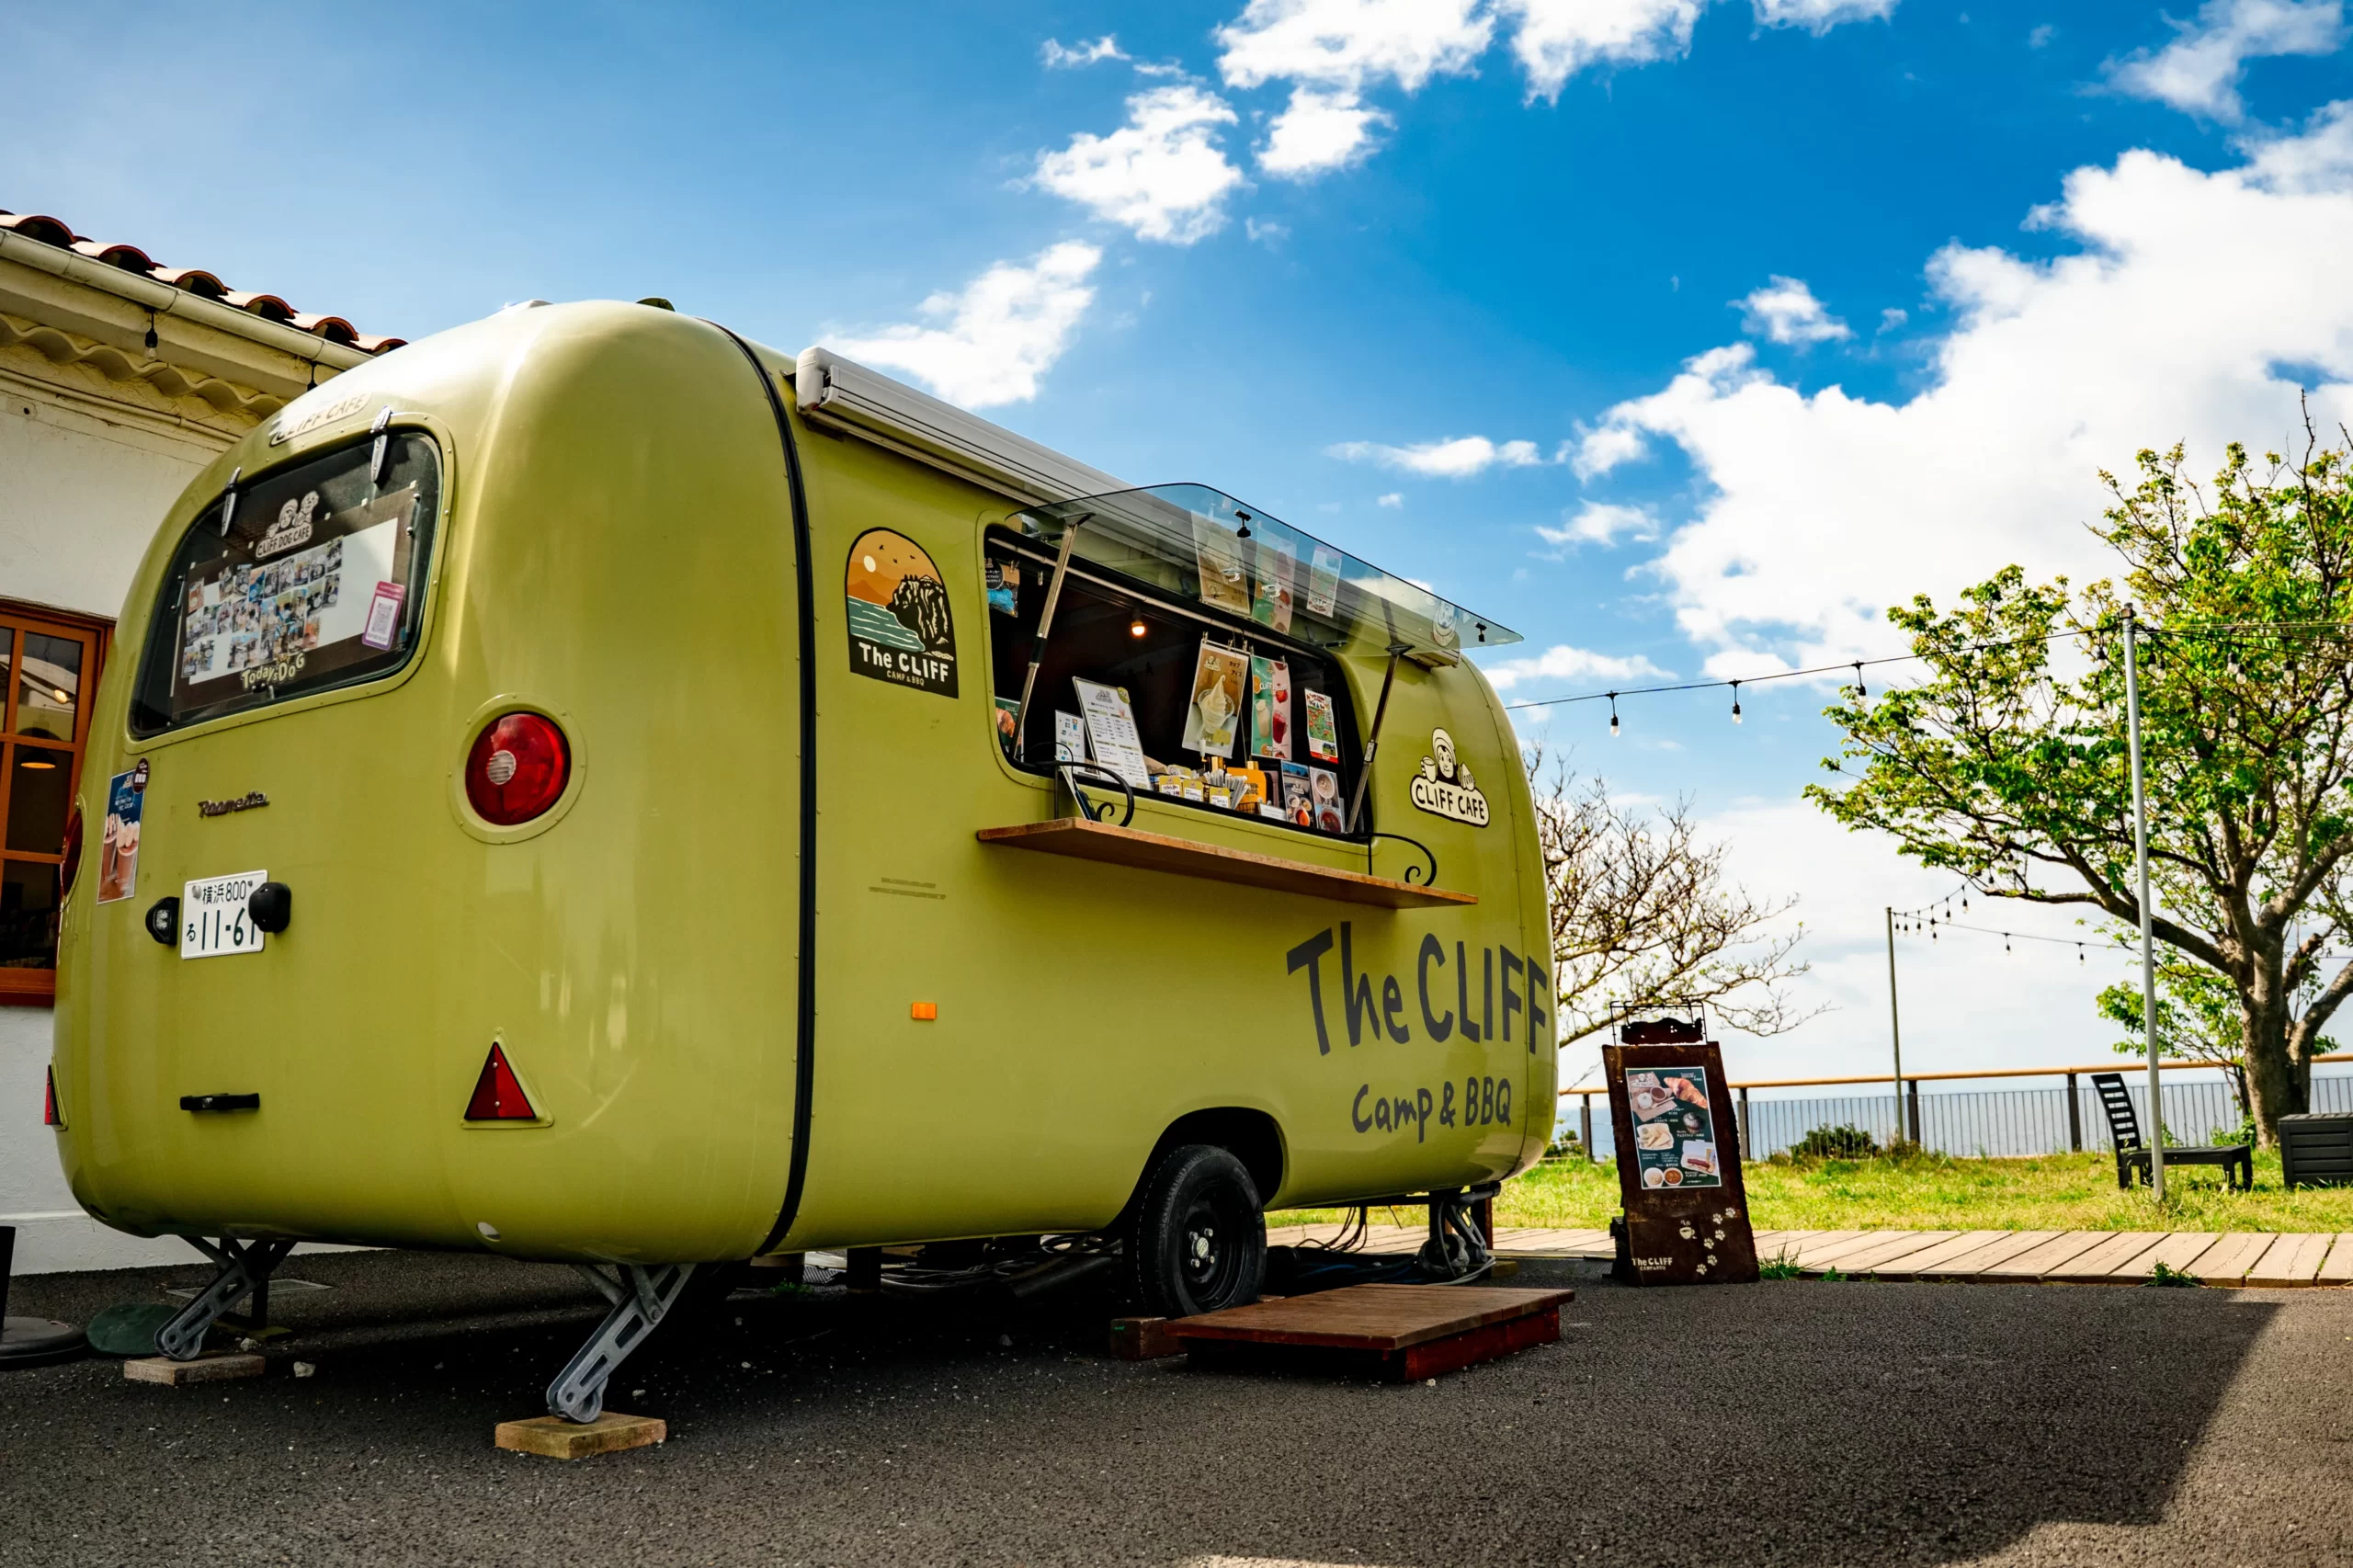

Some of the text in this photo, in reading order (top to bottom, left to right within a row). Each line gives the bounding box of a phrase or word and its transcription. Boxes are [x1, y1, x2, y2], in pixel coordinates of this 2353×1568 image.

[276, 393, 366, 440] CLIFF CAFE
[257, 526, 310, 556] CLIFF DOG CAFE
[858, 642, 949, 682] The CLIFF
[886, 670, 905, 682] CAMP
[912, 676, 925, 687] BBQ
[1415, 784, 1485, 820] CLIFF CAFE
[187, 923, 197, 942] る
[1287, 921, 1548, 1057] The CLIFF
[1352, 1076, 1512, 1143] Camp & BBQ
[1631, 1256, 1673, 1267] The CLIFF
